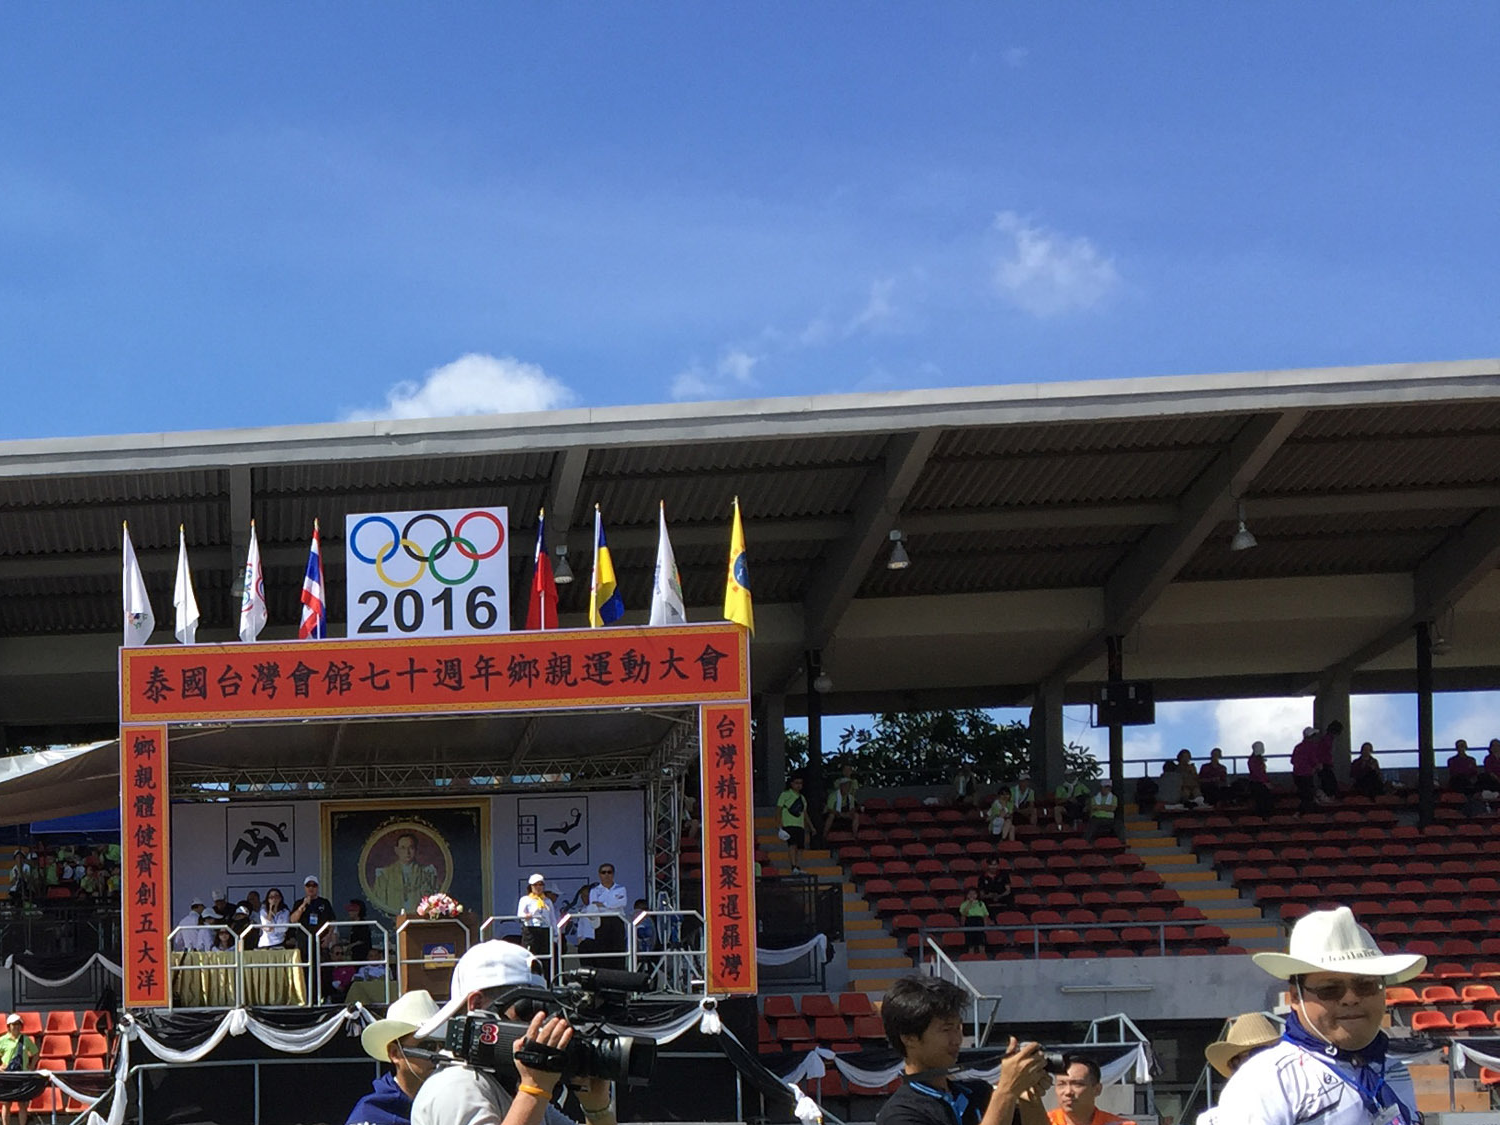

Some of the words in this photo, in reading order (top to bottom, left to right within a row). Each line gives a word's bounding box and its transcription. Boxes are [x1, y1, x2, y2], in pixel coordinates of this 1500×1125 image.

[357, 586, 498, 634] 2016
[142, 644, 729, 704] 泰國台灣會館七十週年鄉親運動大會
[133, 735, 159, 996] 鄉親體健齊創五大洋
[480, 1023, 499, 1045] 3
